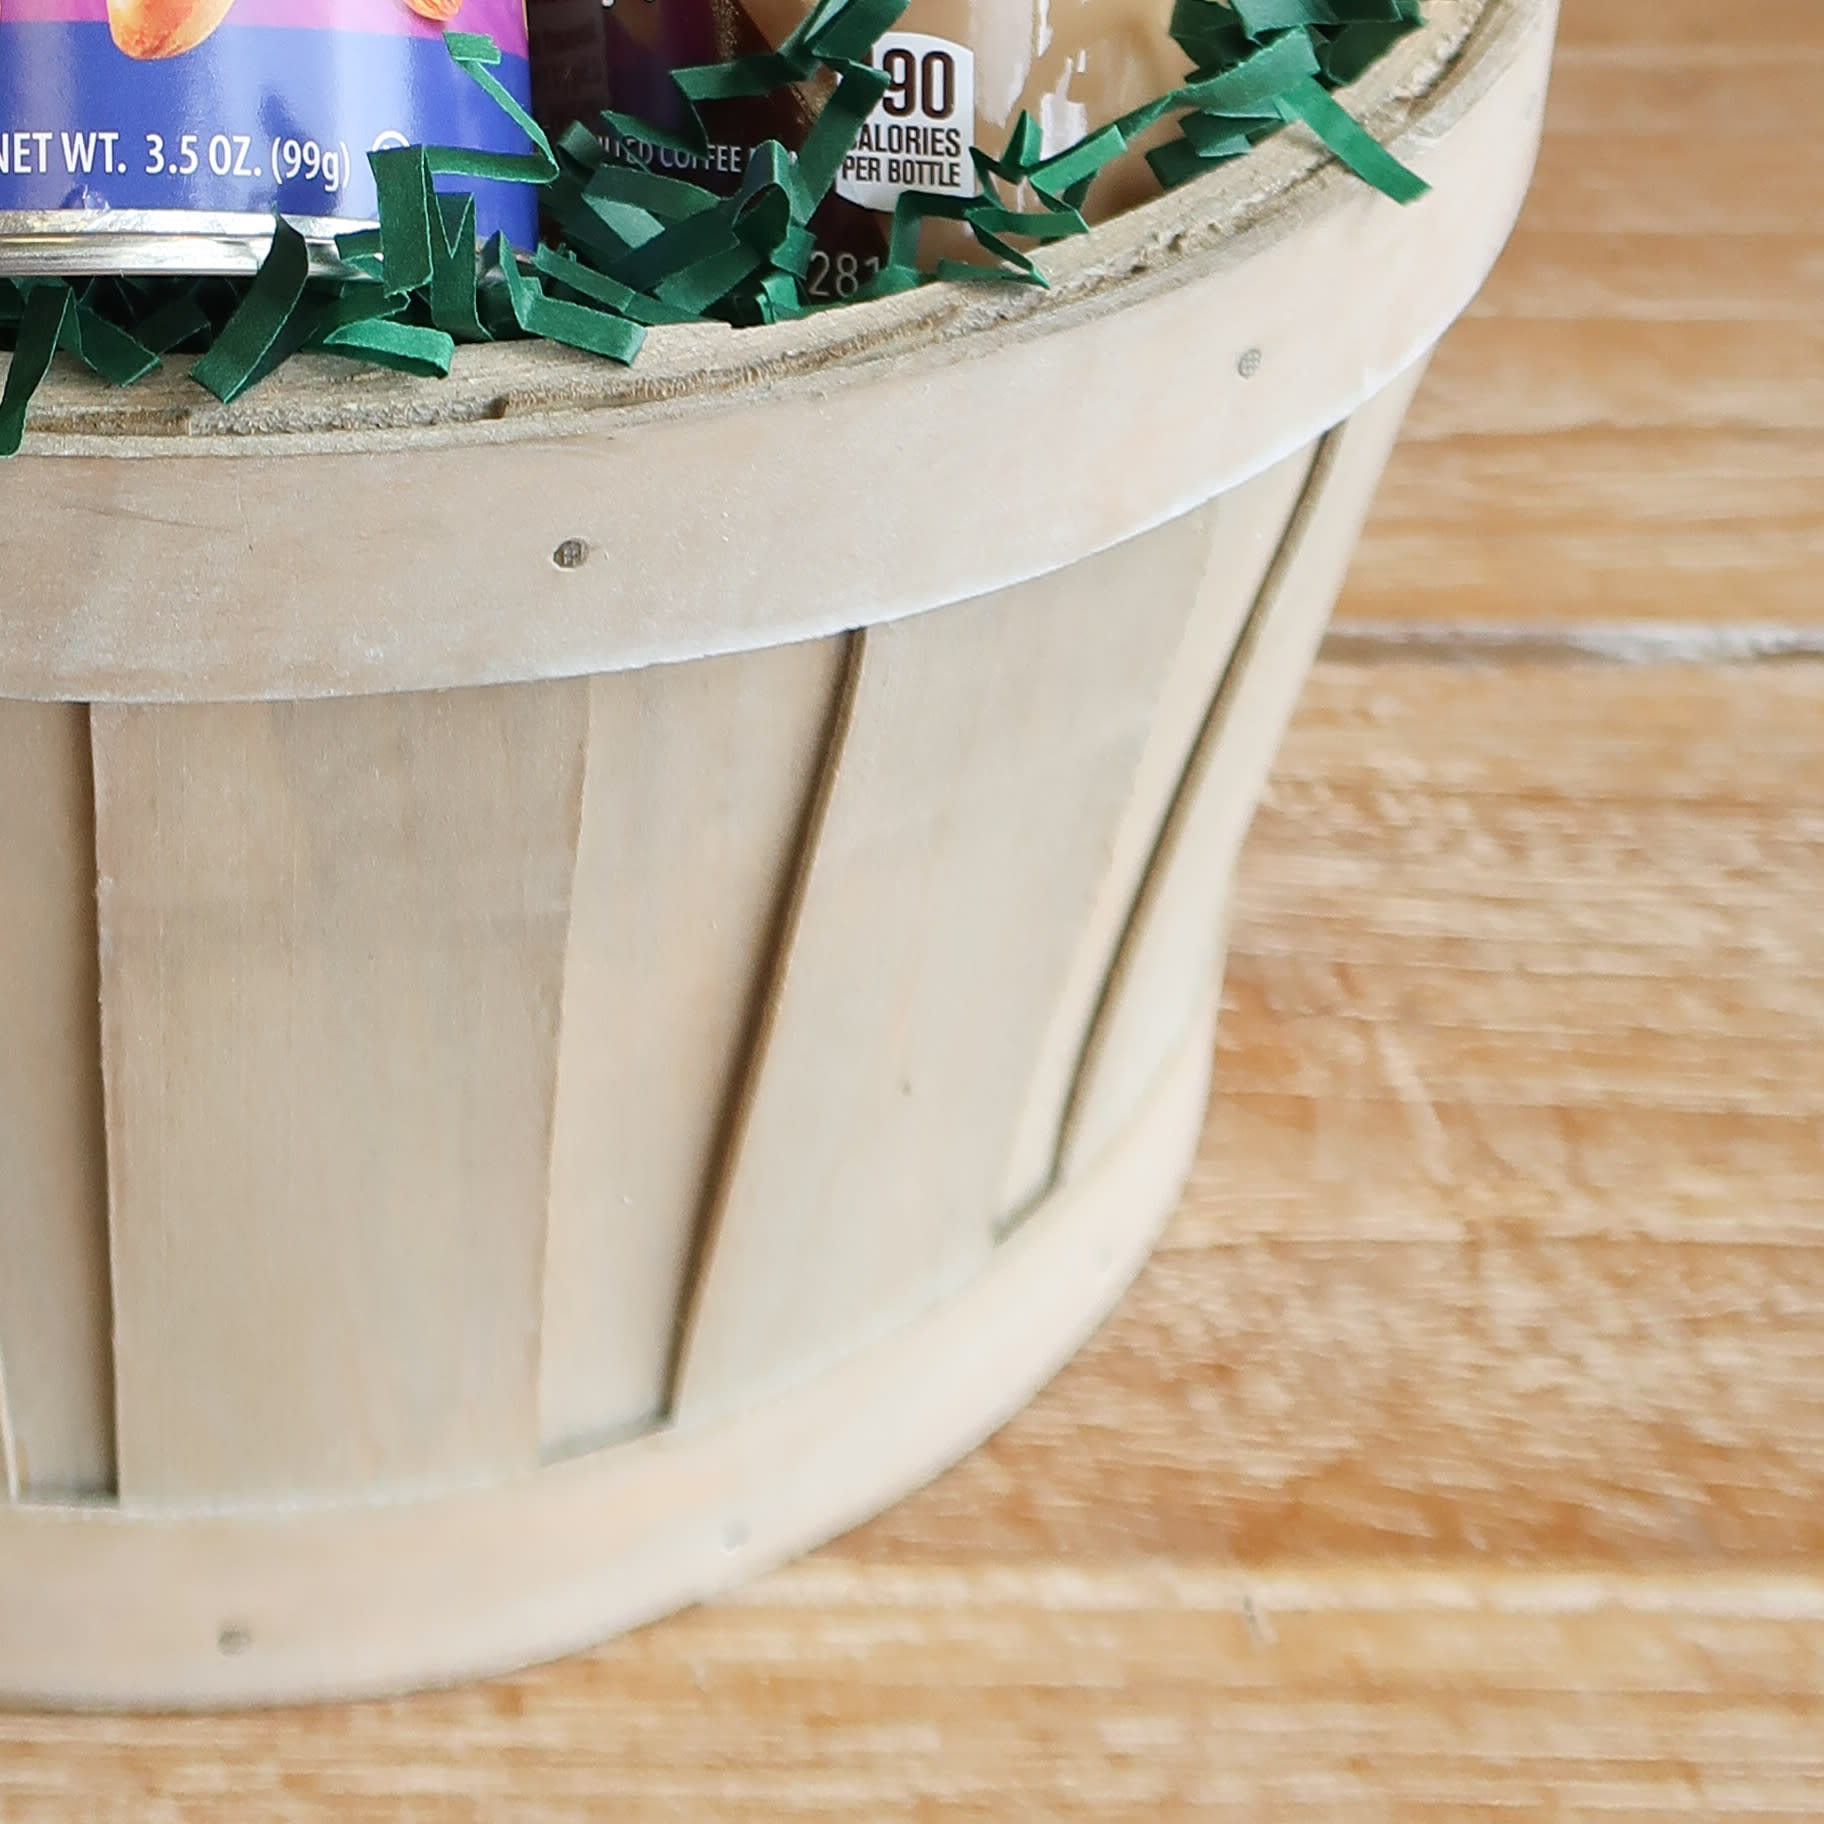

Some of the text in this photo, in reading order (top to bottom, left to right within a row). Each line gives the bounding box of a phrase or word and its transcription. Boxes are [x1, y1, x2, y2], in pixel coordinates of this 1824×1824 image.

[882, 47, 956, 120] 90
[60, 132, 127, 175] WT.
[144, 133, 199, 176] 3.5
[208, 134, 262, 177] OZ.
[271, 135, 351, 193] (99g)
[853, 122, 962, 158] ALORIES
[842, 156, 962, 187] PER BOTTLE
